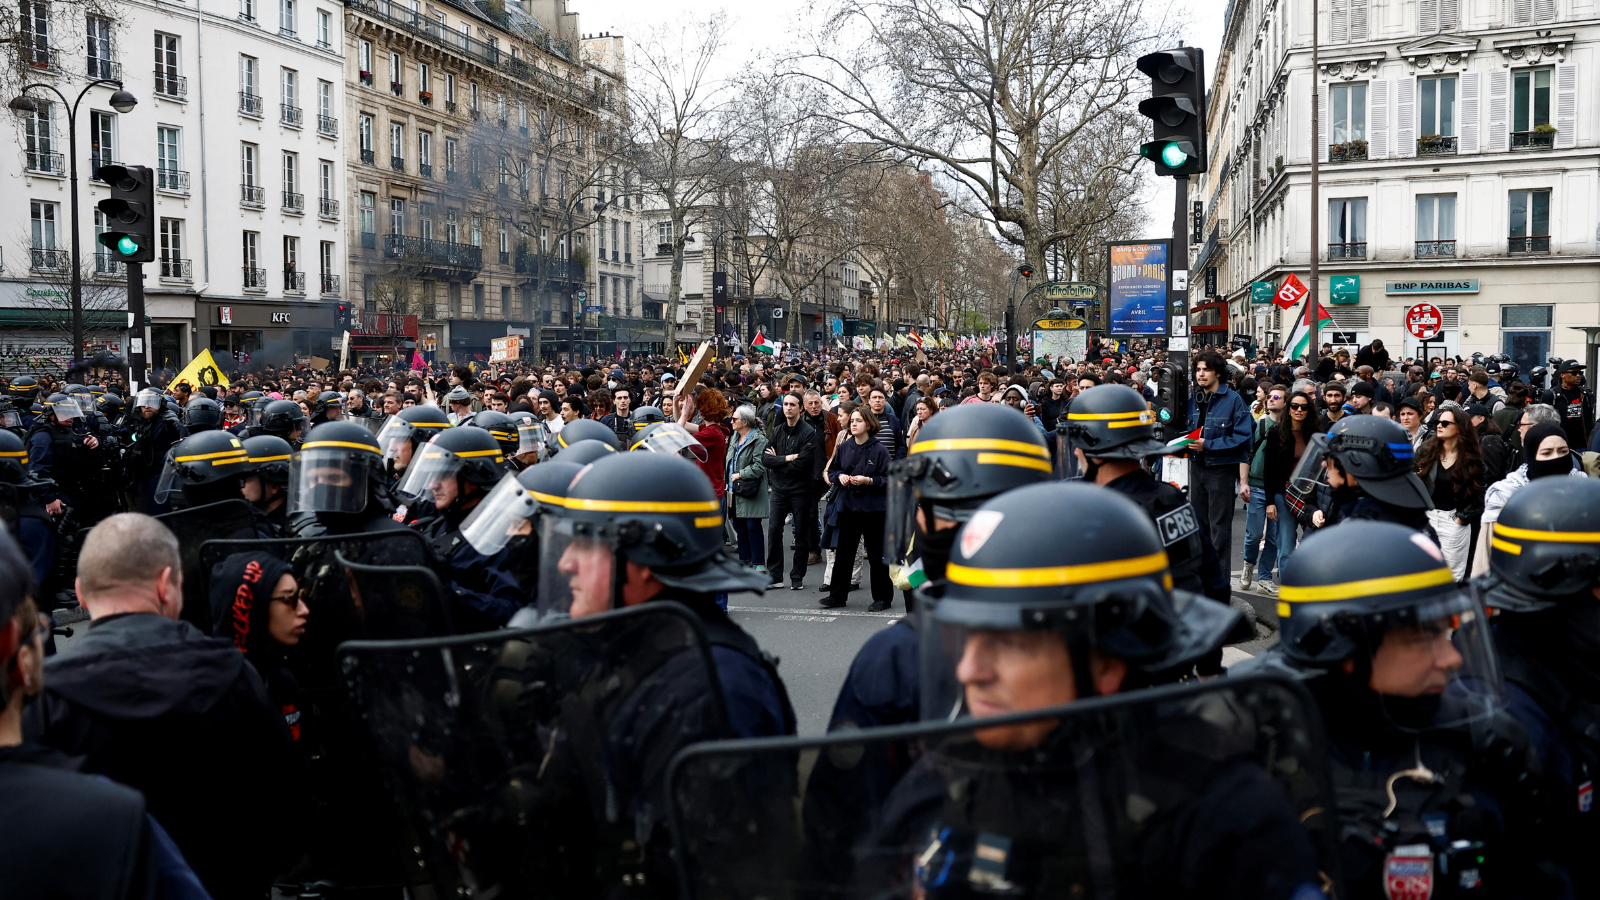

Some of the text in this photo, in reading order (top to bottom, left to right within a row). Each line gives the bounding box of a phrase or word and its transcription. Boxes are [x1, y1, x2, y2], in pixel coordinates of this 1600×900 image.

[1112, 264, 1136, 283] SOUND
[1142, 264, 1166, 282] PARIS
[26, 288, 63, 297] Carrefour
[1394, 282, 1417, 290] BNP
[272, 312, 290, 323] KFC
[359, 315, 379, 334] OCK
[508, 338, 517, 348] LBD
[1164, 508, 1195, 540] CRS
[242, 560, 264, 583] UP
